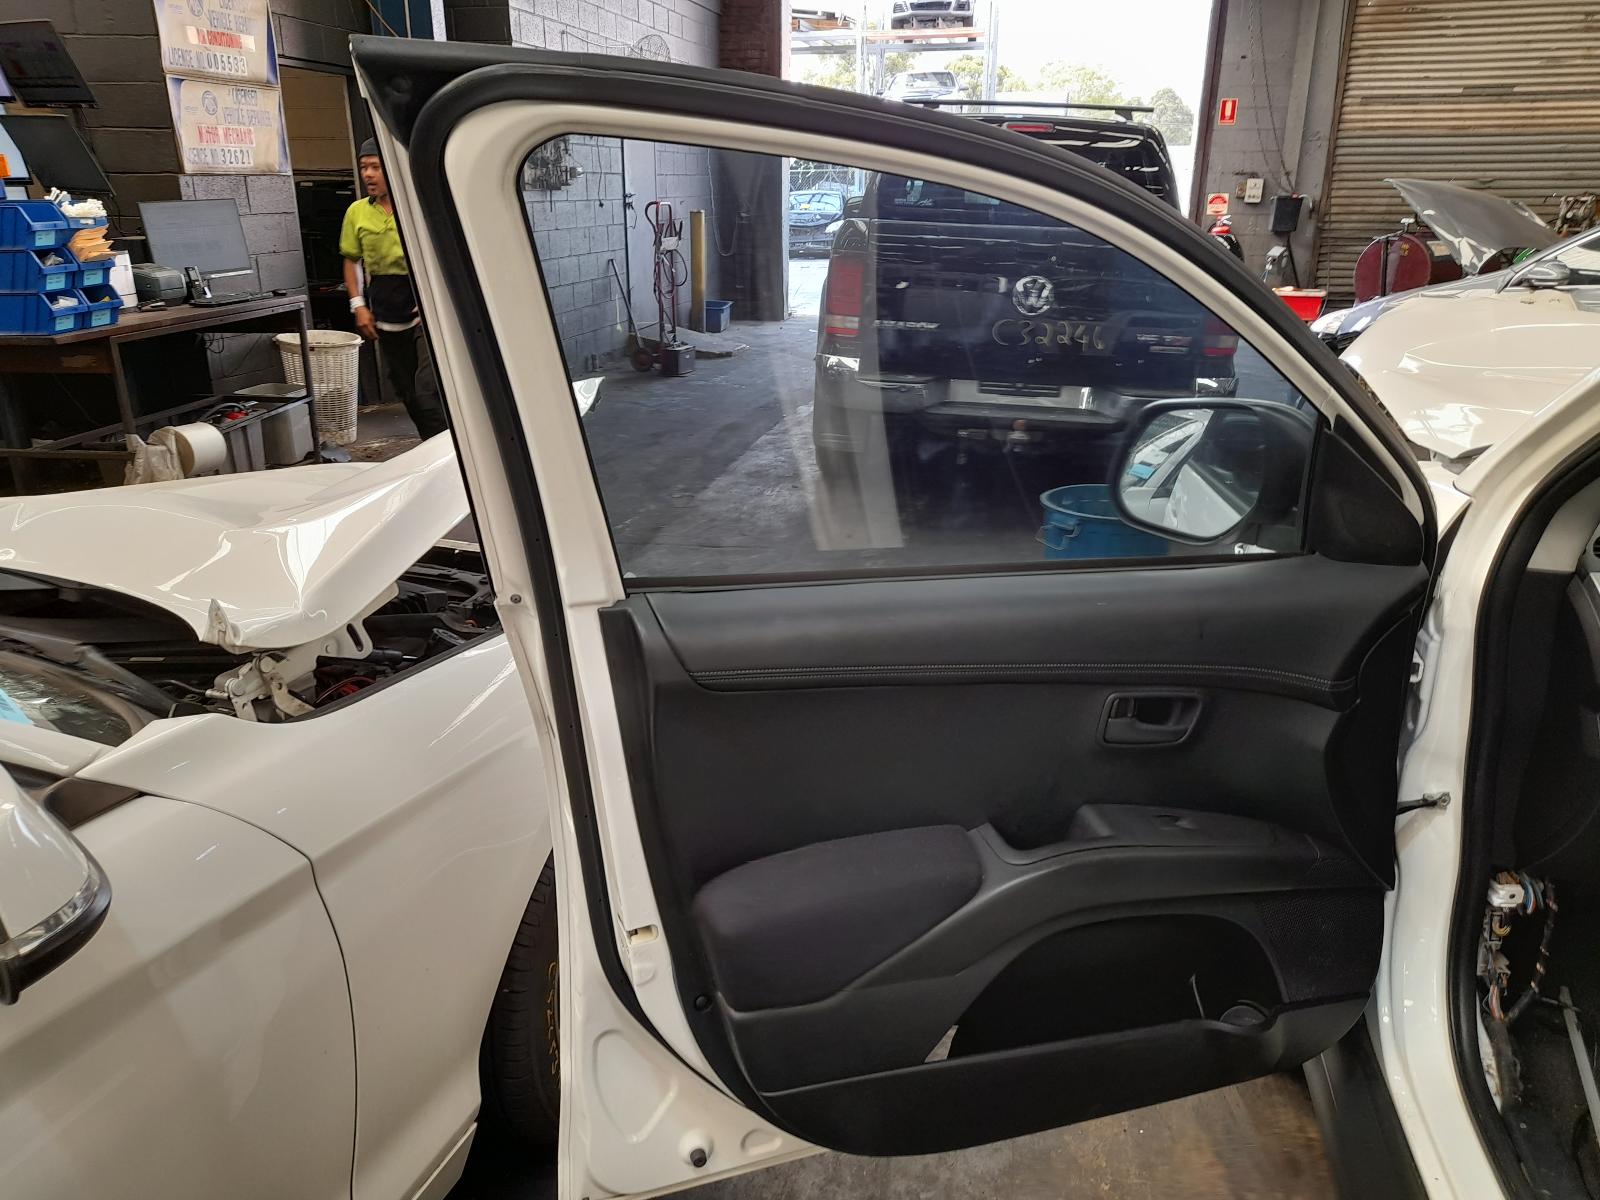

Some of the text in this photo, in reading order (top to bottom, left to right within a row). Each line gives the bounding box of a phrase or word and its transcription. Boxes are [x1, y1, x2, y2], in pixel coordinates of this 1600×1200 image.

[206, 52, 246, 74] 005533
[197, 125, 255, 146] MOTOR MECHANIC
[221, 148, 253, 165] 32621
